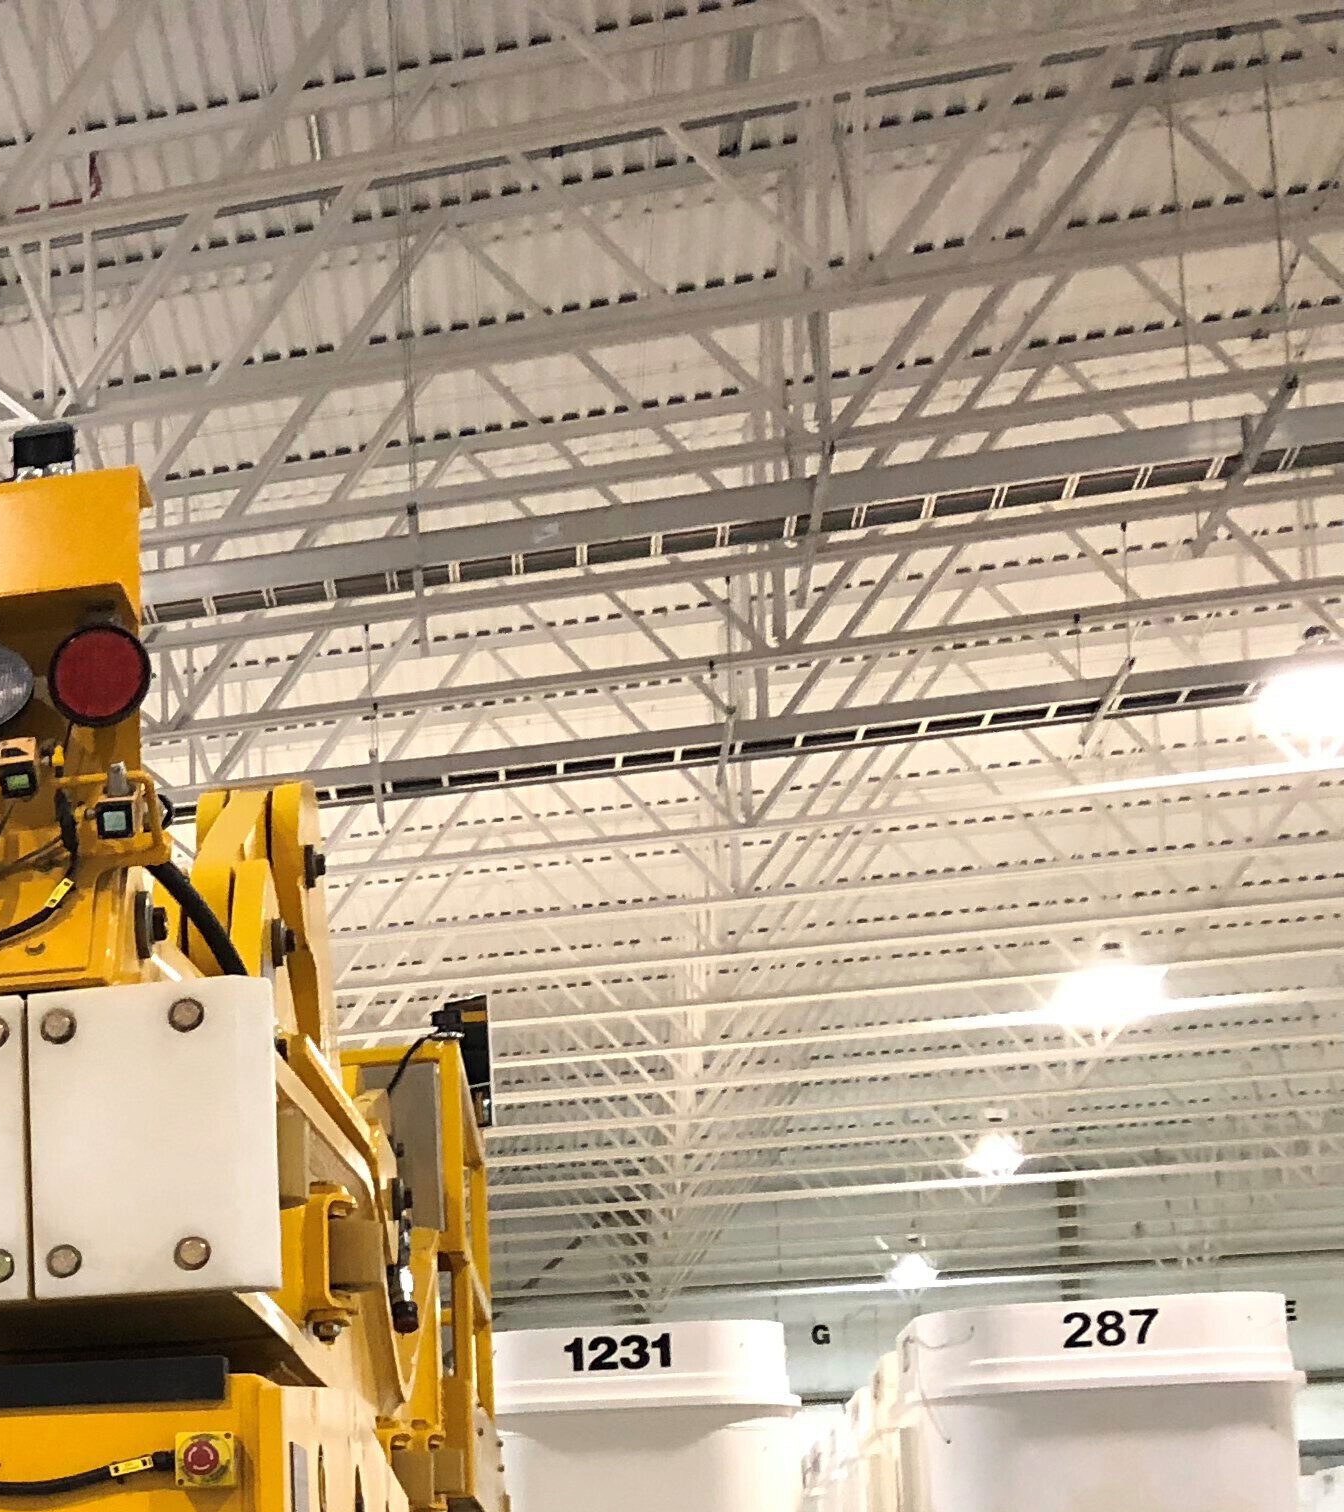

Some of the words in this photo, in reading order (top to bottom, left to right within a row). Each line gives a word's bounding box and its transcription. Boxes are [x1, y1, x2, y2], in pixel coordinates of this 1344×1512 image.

[811, 1324, 831, 1345] G
[1062, 1308, 1160, 1349] 287
[563, 1332, 673, 1373] 1231
